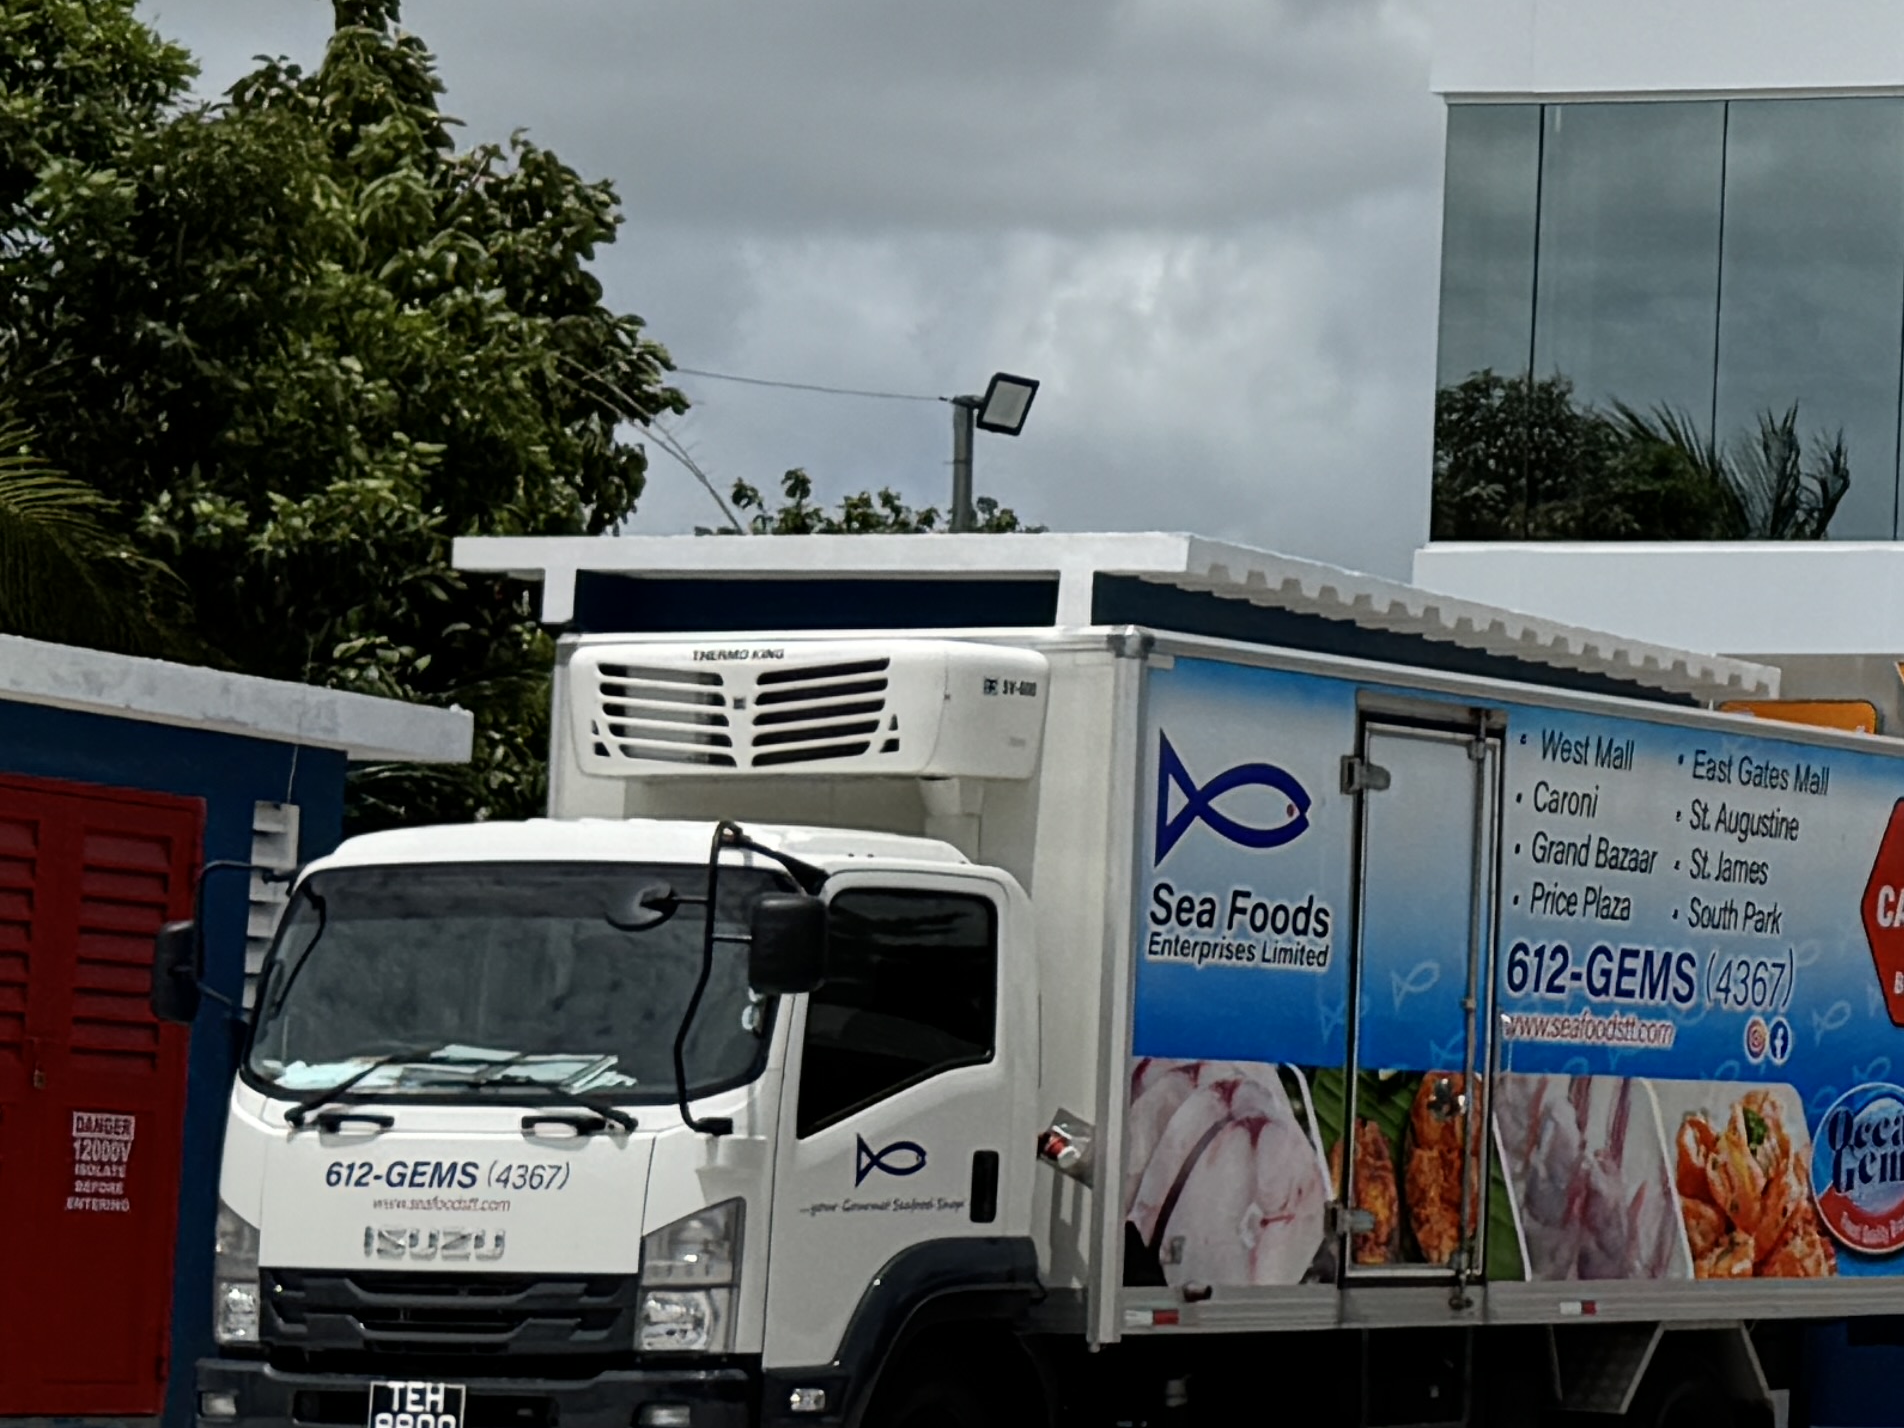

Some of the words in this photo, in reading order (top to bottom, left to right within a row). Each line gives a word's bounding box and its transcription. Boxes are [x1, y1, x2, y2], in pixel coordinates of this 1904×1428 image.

[1541, 729, 1589, 766] West
[1595, 736, 1635, 771] Mall
[1692, 750, 1733, 785] East
[1738, 756, 1789, 791] Gates
[1793, 763, 1830, 796] Mall
[1533, 780, 1599, 818] Caroni
[1690, 799, 1711, 832] St.
[1714, 803, 1800, 842] Augustine
[1531, 831, 1591, 867] Grand
[1595, 837, 1658, 875] Bazaar
[1690, 848, 1711, 880] St.
[1714, 851, 1769, 886] James
[1150, 883, 1216, 928] Sea
[1227, 889, 1331, 938] Foods
[1530, 881, 1578, 917] Price
[1583, 885, 1631, 921] Plaza
[1688, 896, 1739, 930] South
[1743, 902, 1782, 935] Park
[1148, 931, 1256, 965] Enterprises
[1261, 940, 1330, 967] Limited
[1507, 941, 1697, 1004] 612-GEMS
[1706, 948, 1794, 1008] (4367)
[76, 1115, 131, 1135] DANGER
[74, 1163, 126, 1178] ISOLATE
[74, 1179, 124, 1195] BEFORE
[325, 1160, 479, 1188] 612-GEMS
[487, 1160, 570, 1190] (4367)
[66, 1196, 130, 1211] ENTERING
[364, 1225, 505, 1261] ISUZU
[387, 1380, 445, 1412] TEH
